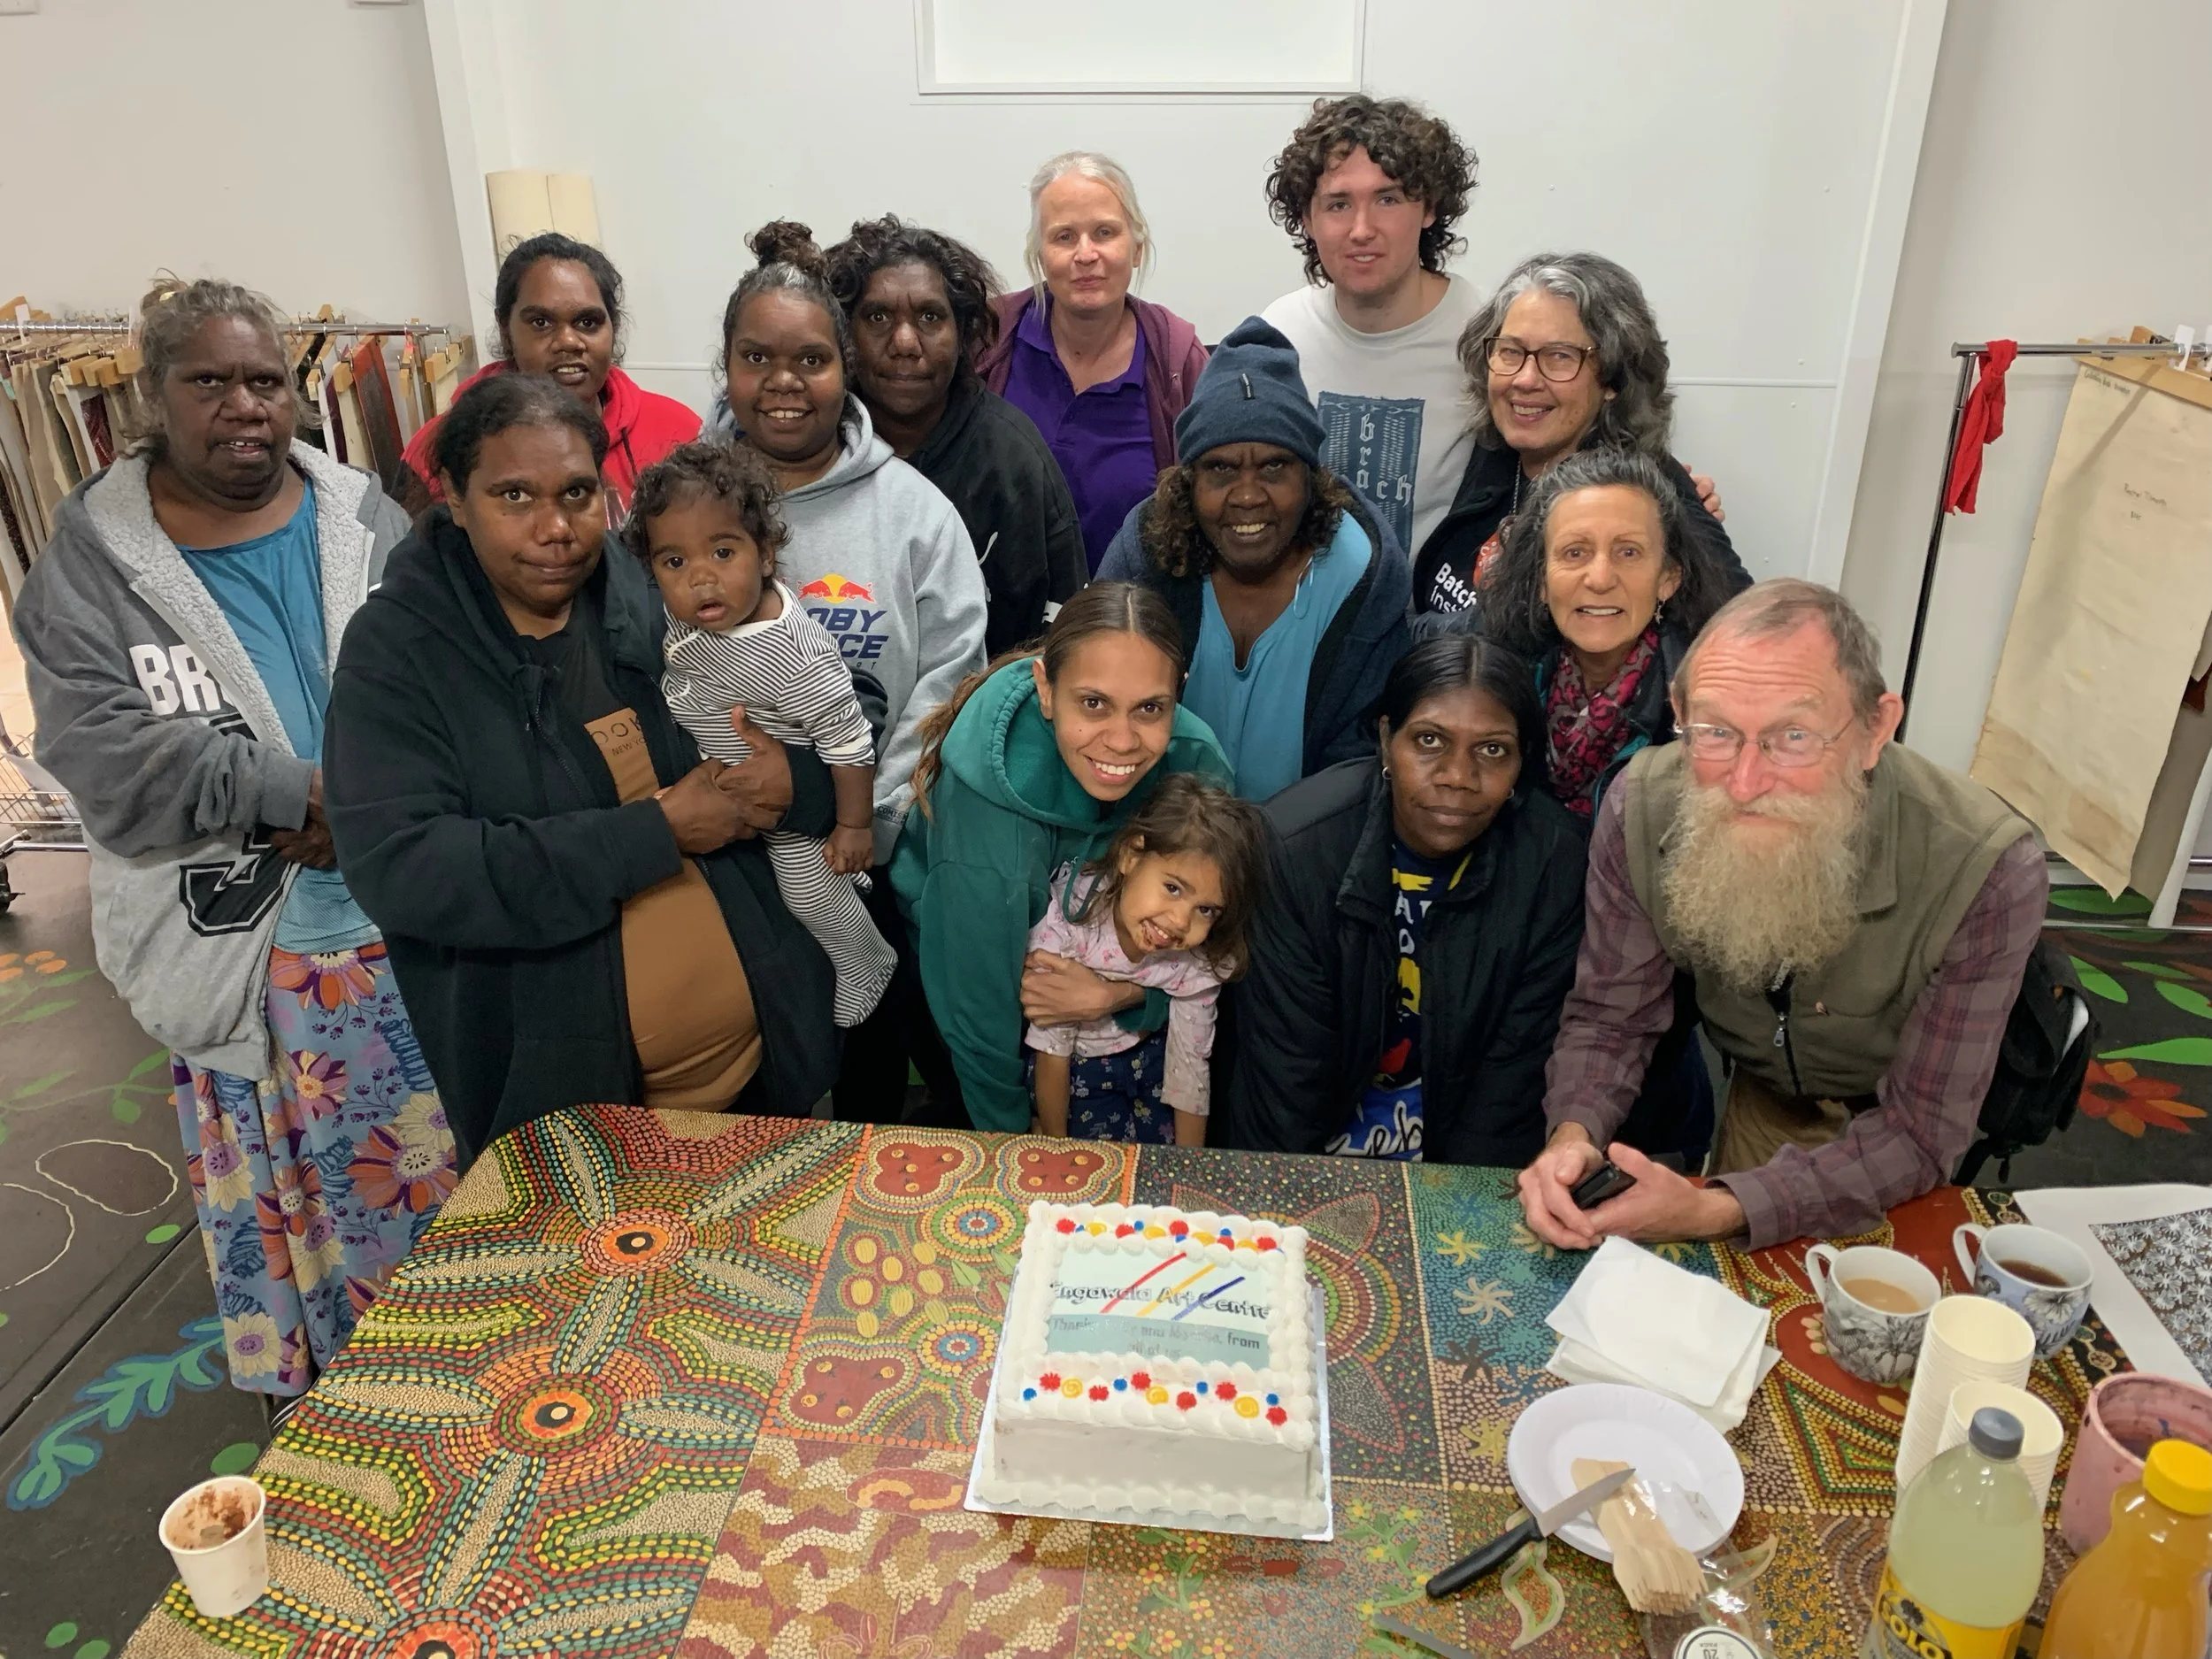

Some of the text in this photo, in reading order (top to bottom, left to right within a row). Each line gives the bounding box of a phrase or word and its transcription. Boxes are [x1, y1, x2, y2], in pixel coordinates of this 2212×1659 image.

[1434, 562, 1477, 608] Batch
[806, 607, 887, 633] OBY
[833, 633, 889, 658] CE
[128, 643, 234, 716] BR
[611, 742, 634, 756] NEW
[1156, 1286, 1194, 1307] Art
[1198, 1292, 1269, 1320] Centre
[1227, 1332, 1260, 1349] from
